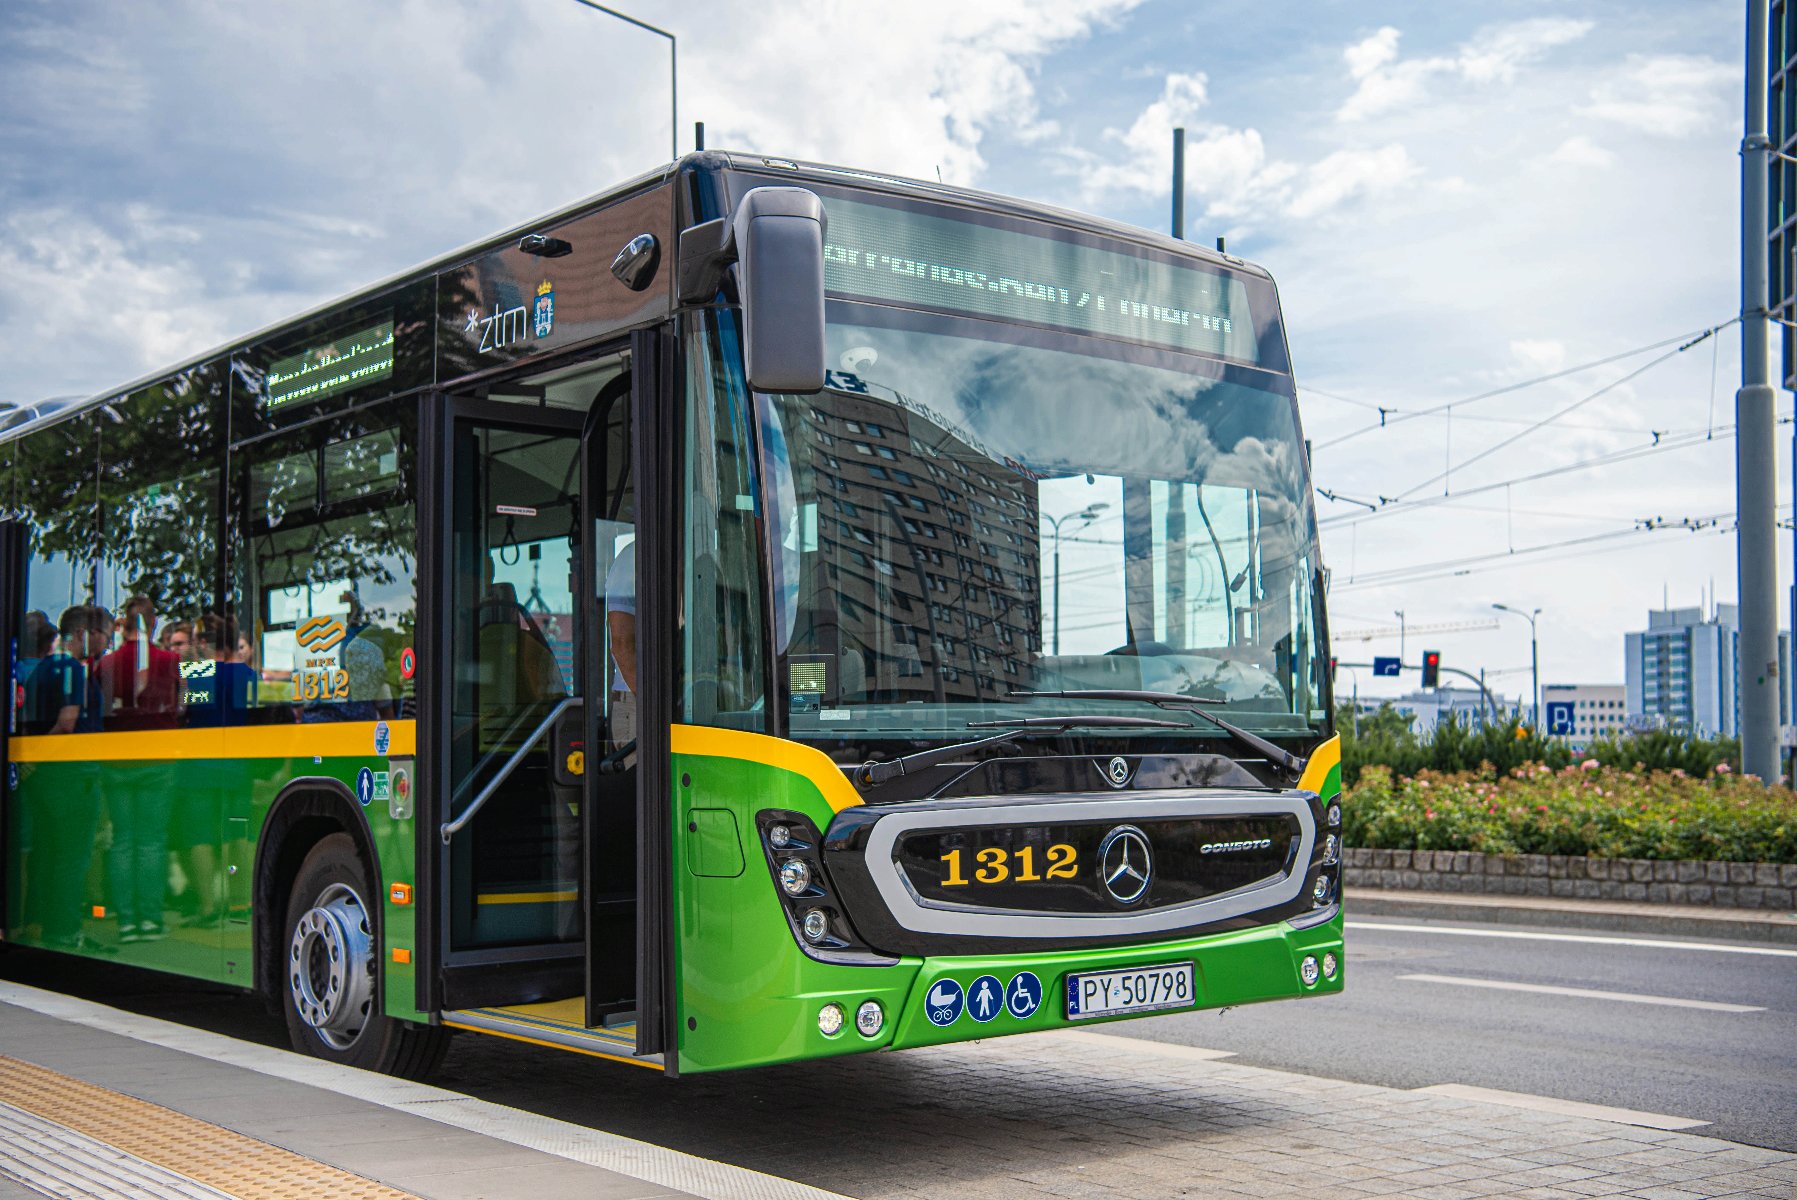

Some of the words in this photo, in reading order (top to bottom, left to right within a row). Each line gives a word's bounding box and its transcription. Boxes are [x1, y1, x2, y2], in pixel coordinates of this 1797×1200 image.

[305, 656, 336, 668] MPK
[291, 669, 350, 701] 1312
[1199, 838, 1271, 854] CONECTO
[940, 843, 1078, 887] 1312
[1083, 977, 1112, 1010] PY
[1121, 970, 1187, 1005] 50798
[1069, 1001, 1078, 1010] PL
